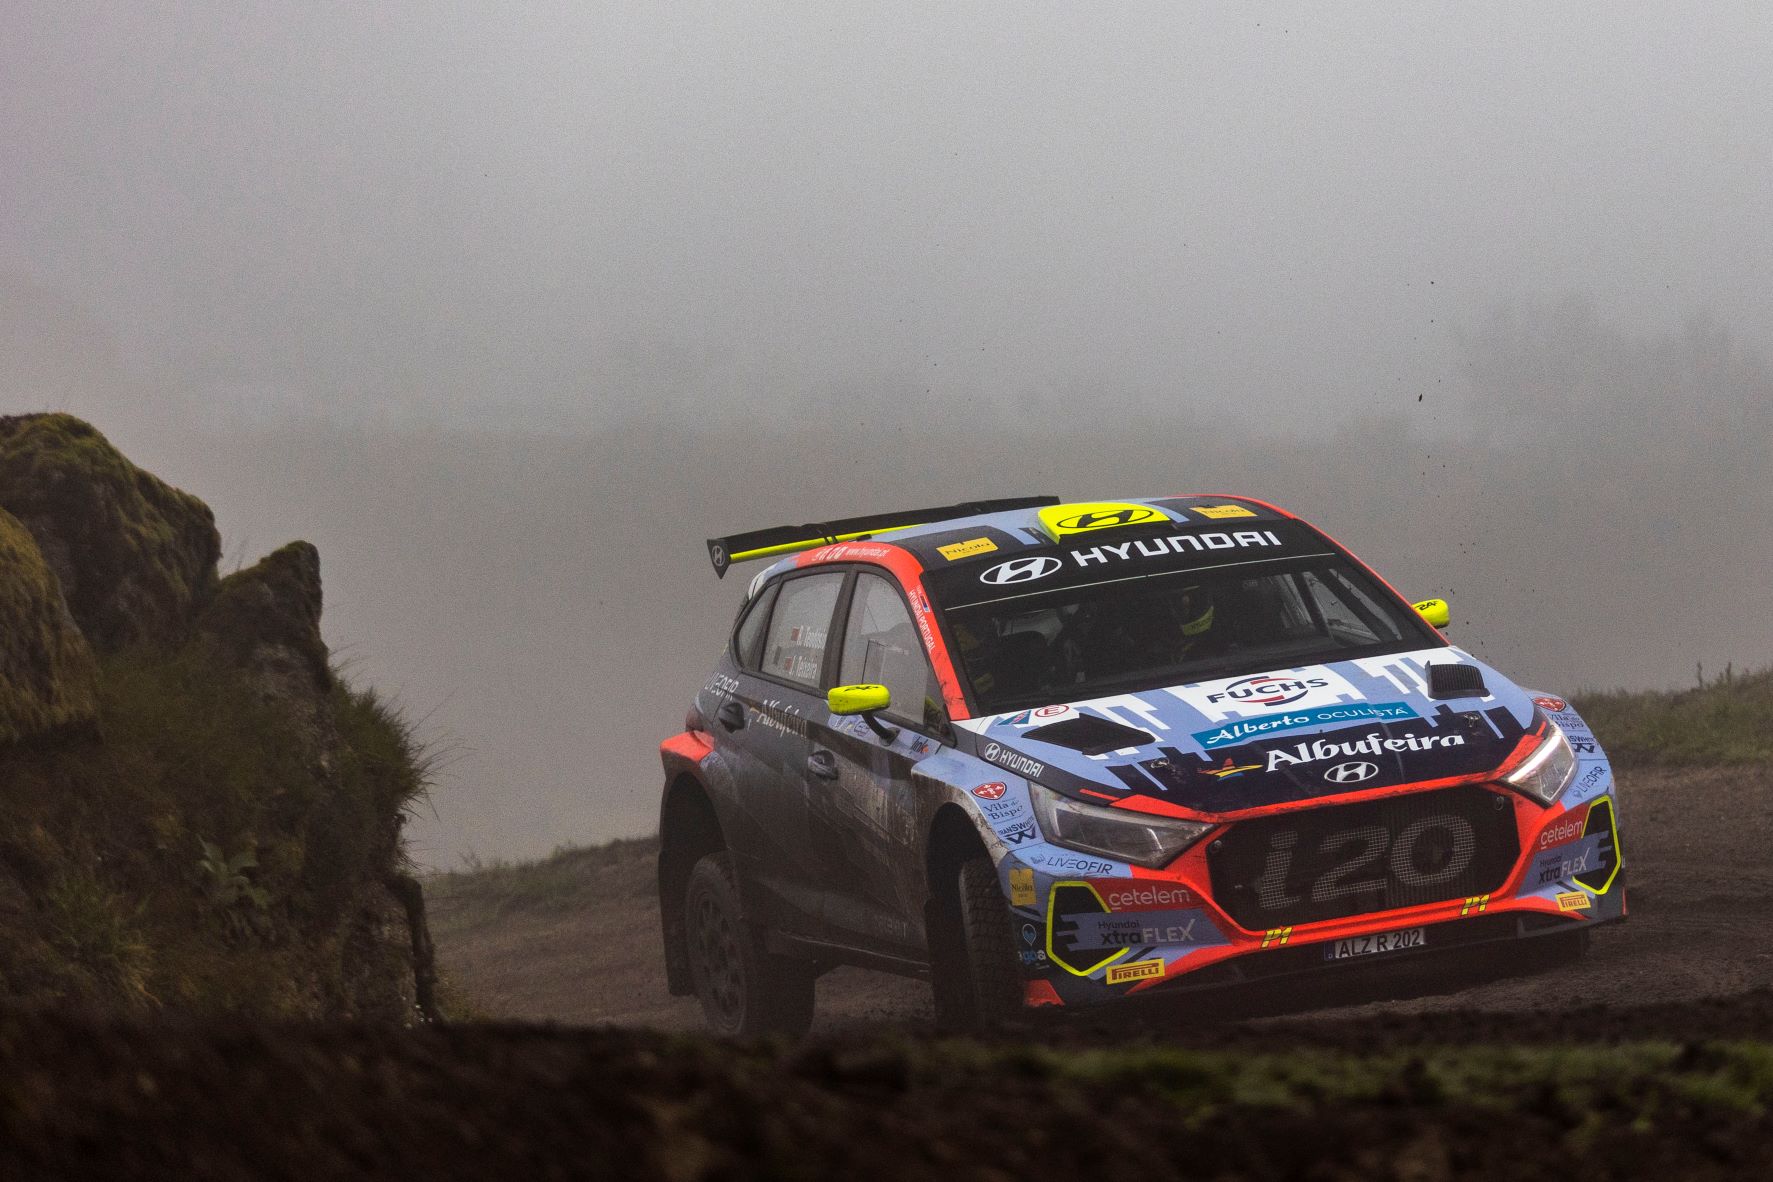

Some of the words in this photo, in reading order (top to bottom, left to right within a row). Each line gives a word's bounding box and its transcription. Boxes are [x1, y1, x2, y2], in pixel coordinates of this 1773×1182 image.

[1070, 530, 1282, 567] HYUNDAI
[908, 589, 924, 618] HYUNDAI
[918, 616, 936, 655] PORTUGAL
[1206, 677, 1329, 704] FUCHS
[1206, 714, 1310, 746] Alberto
[1317, 707, 1409, 721] OCULISTA
[1555, 721, 1584, 729] ispo
[999, 749, 1045, 778] HYUNDAI
[1265, 732, 1465, 773] Albufeira
[983, 801, 1009, 813] Vila
[988, 805, 1023, 820] Bispo
[1540, 820, 1583, 848] cetelem
[1047, 856, 1113, 875] LIVEOFIR
[1539, 847, 1590, 883] xtraFLEX
[1108, 886, 1191, 908] cetelem
[1560, 895, 1587, 908] PIRELLI
[1097, 919, 1141, 930] Hyundai
[1100, 918, 1197, 945] xtraFLEX
[1338, 937, 1372, 958] ALZ
[1376, 934, 1389, 952] R
[1393, 930, 1421, 949] 202
[1111, 962, 1160, 981] PIRELLI
